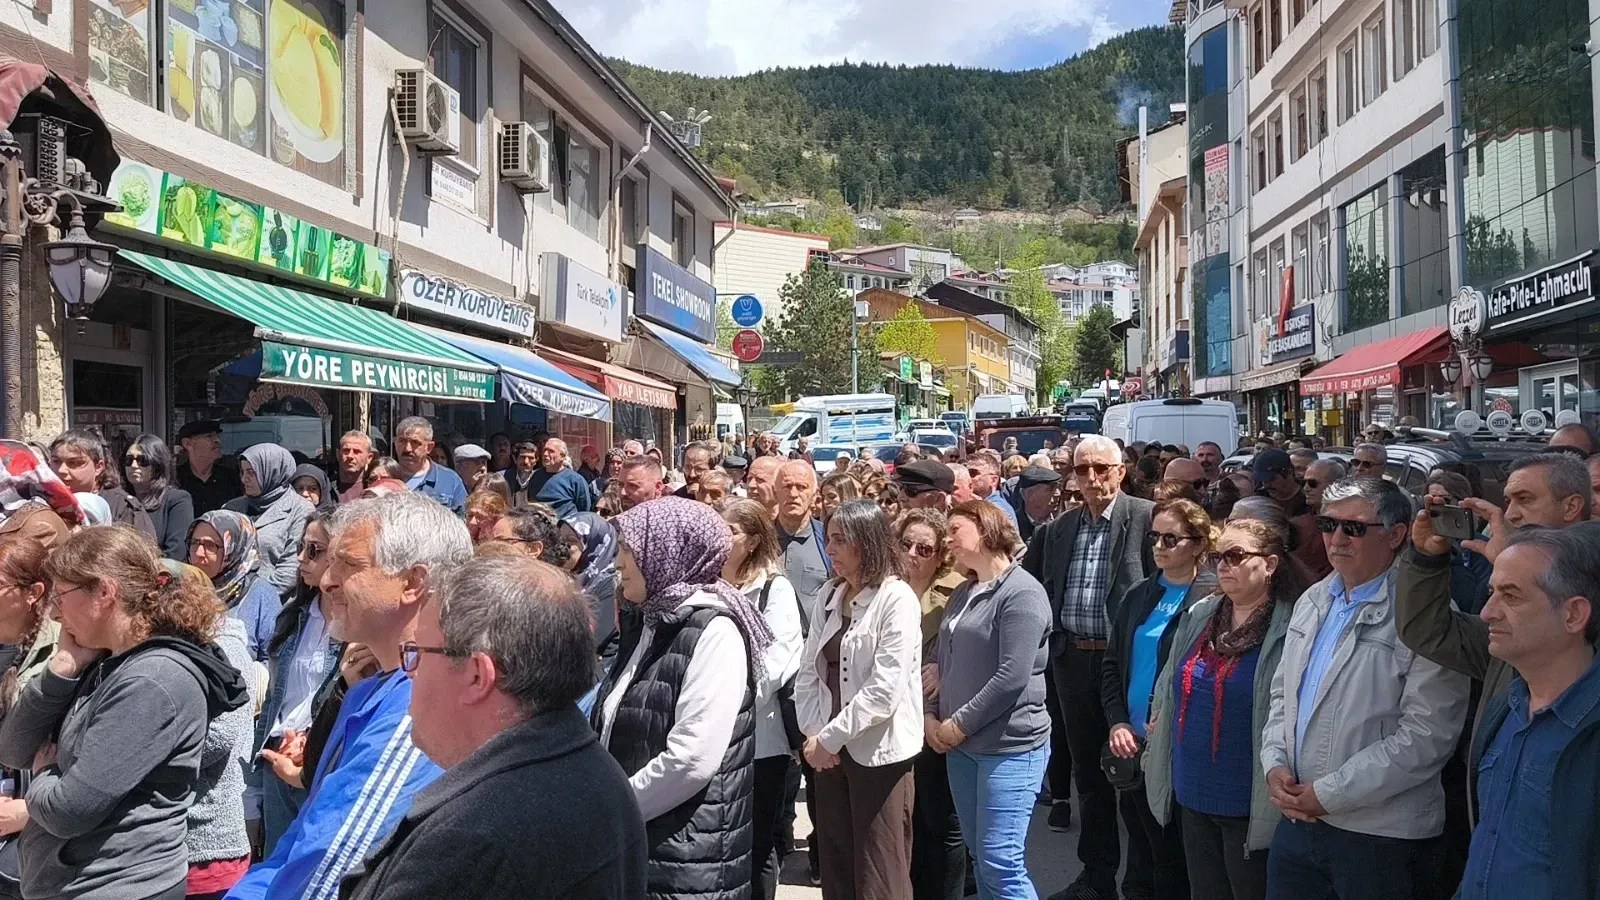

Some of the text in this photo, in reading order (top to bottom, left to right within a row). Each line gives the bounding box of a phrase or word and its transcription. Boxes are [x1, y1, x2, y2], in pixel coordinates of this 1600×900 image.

[576, 282, 609, 310] Türk Telekom
[652, 271, 711, 323] TEKEL SHOWROOM
[1452, 301, 1478, 326] Lezzet
[281, 347, 448, 393] YÖRE PEYNİRCİSİ
[617, 382, 634, 398] YAP
